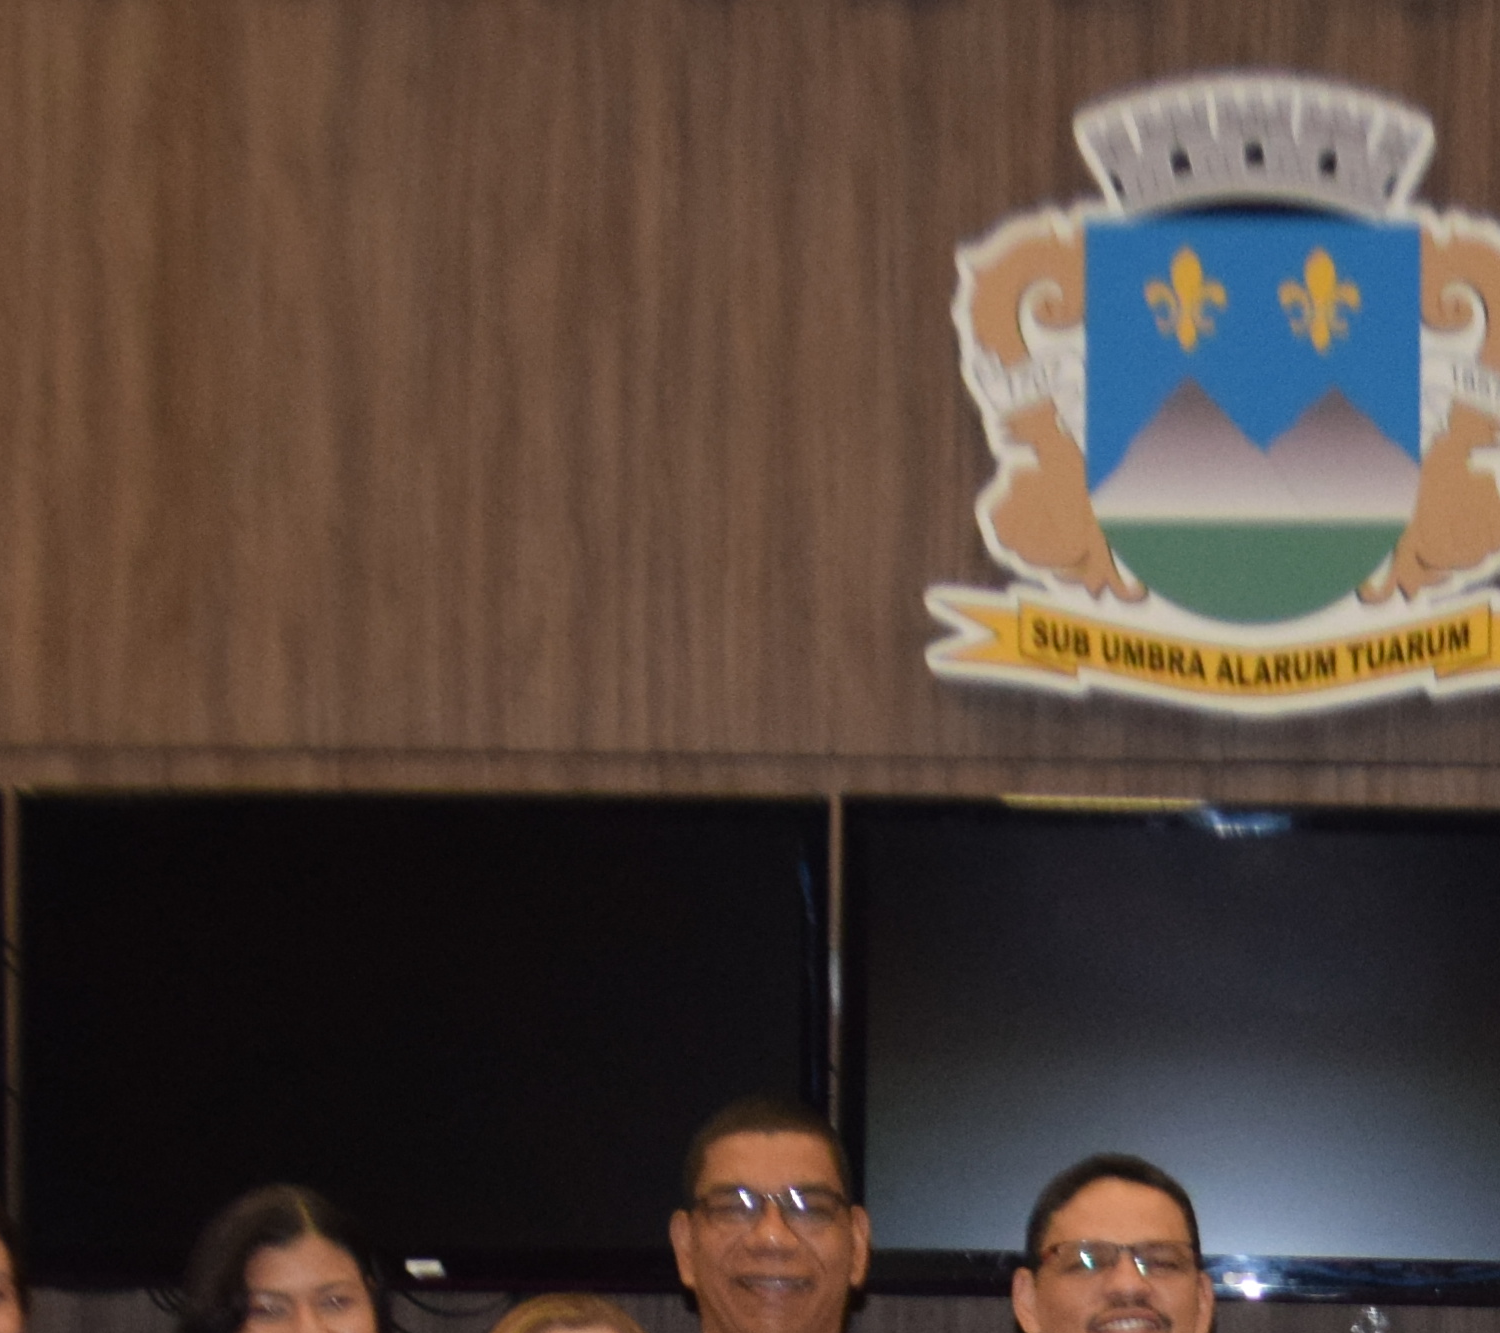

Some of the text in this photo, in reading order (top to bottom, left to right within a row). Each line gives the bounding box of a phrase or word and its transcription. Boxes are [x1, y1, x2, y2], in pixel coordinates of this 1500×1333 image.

[1032, 618, 1471, 685] SUB UMBRA ALARUM TUARUM
